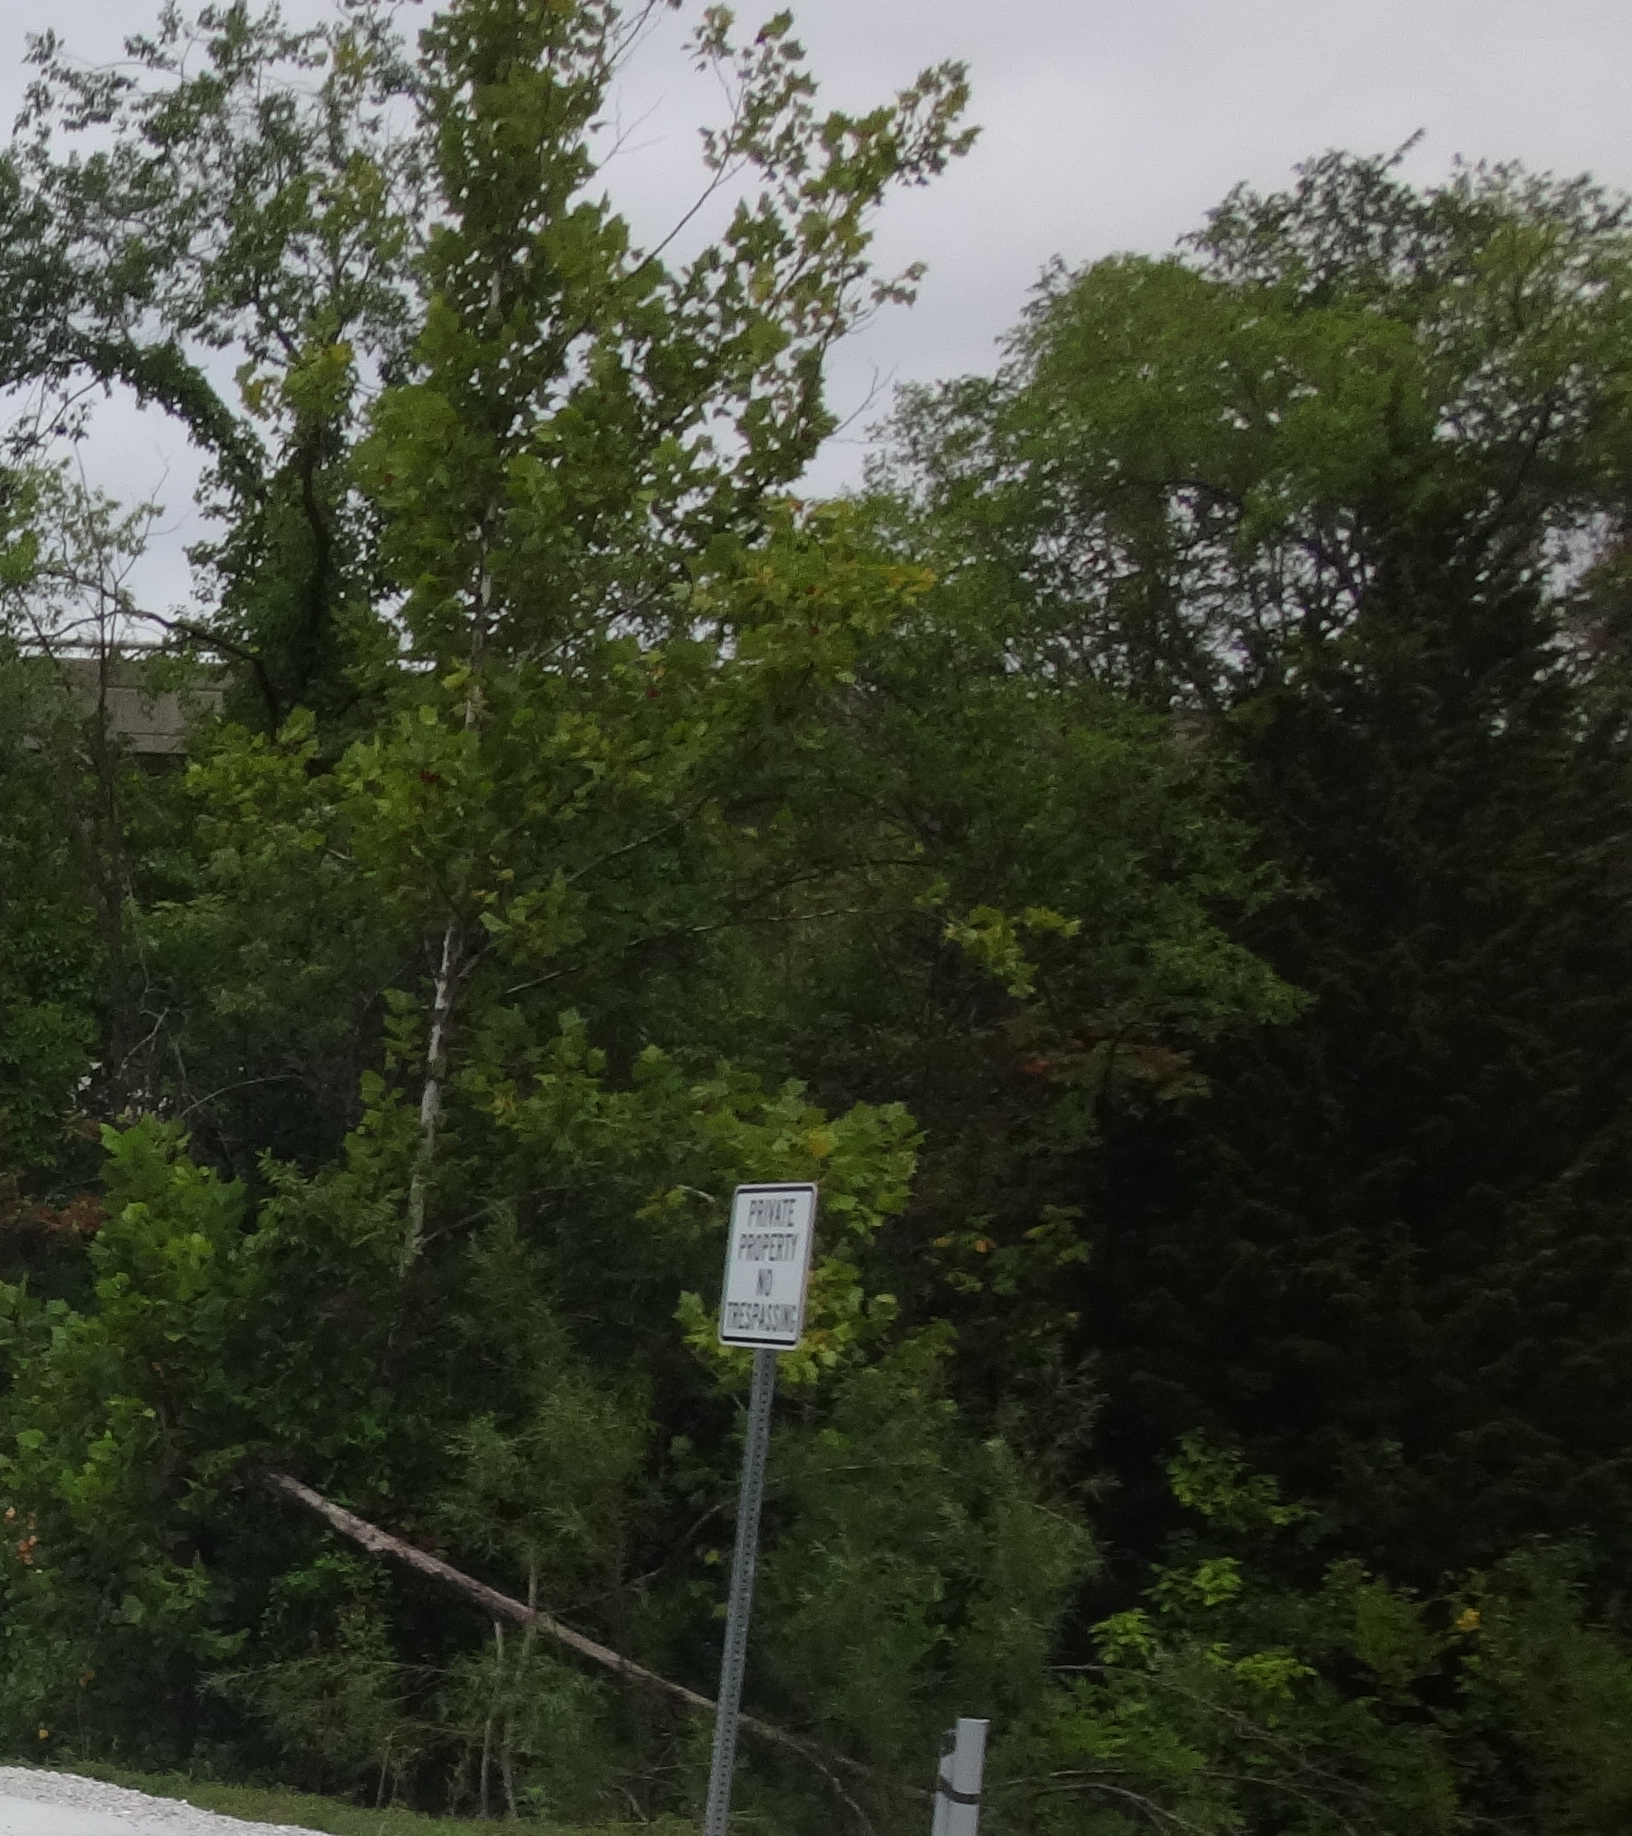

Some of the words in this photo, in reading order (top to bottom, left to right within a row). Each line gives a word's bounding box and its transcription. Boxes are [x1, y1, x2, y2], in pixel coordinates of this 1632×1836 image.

[747, 1198, 797, 1228] PRIVATE
[737, 1233, 800, 1262] PROPERTY
[756, 1268, 773, 1297] NO
[726, 1301, 798, 1334] TRESPASSING
